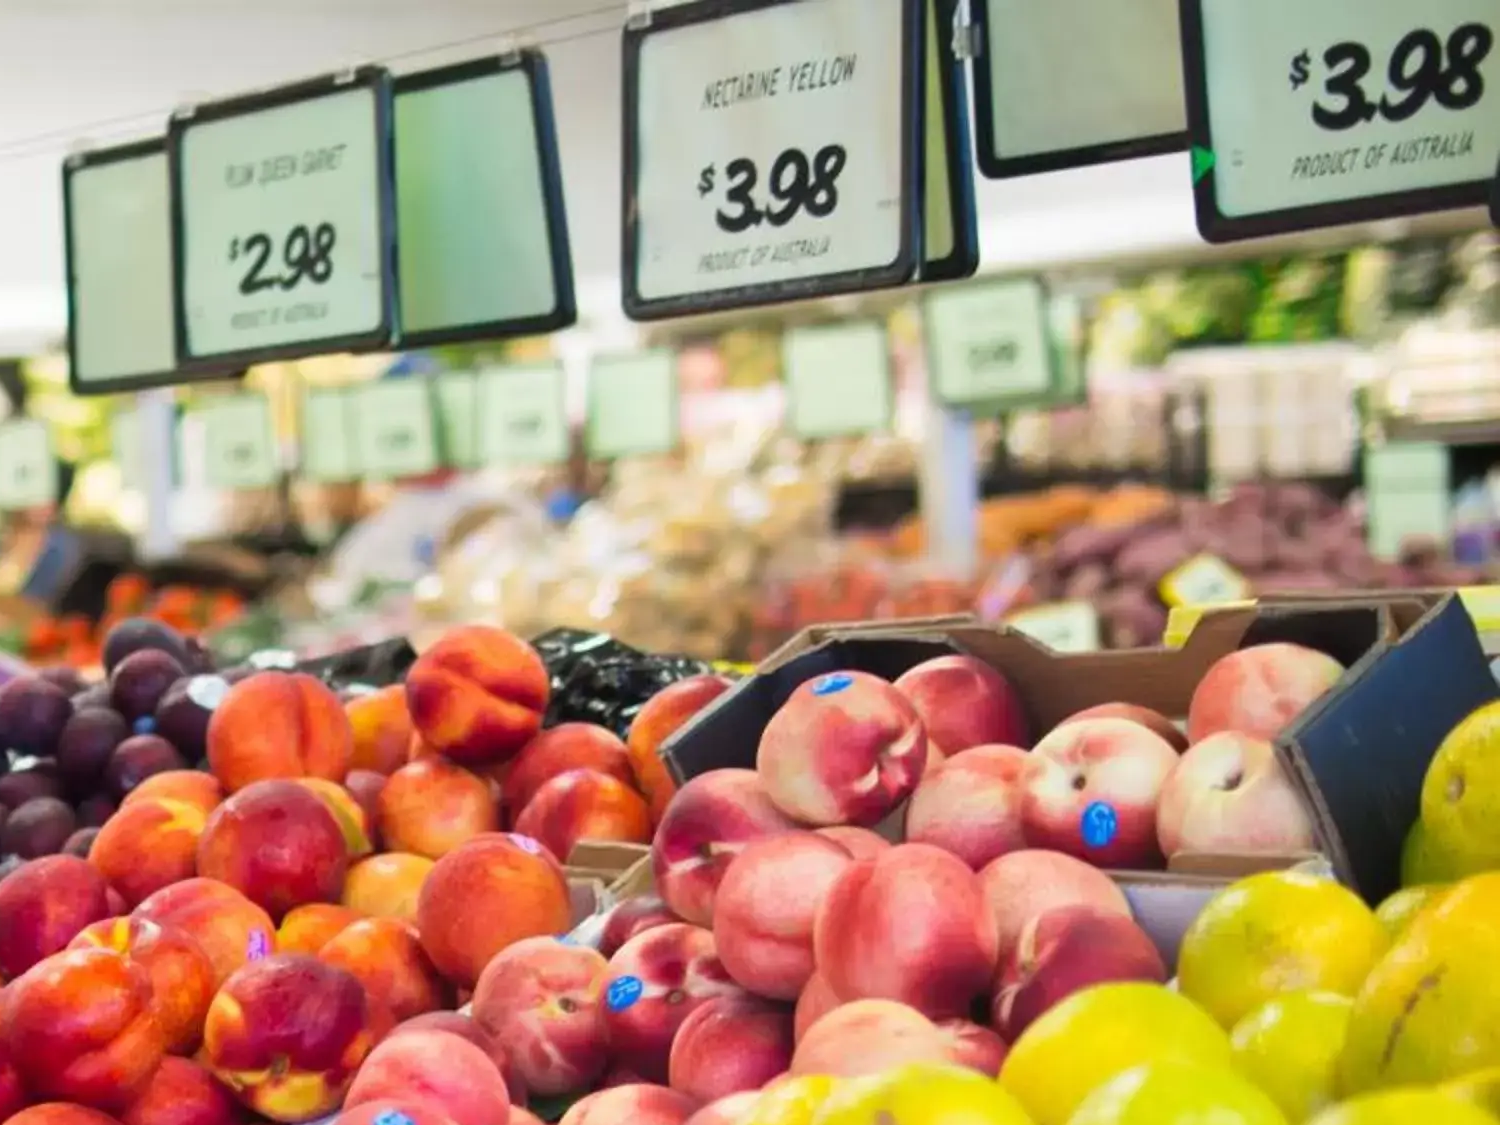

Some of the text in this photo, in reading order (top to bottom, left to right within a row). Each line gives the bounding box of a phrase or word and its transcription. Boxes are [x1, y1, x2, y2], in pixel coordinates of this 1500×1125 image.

[700, 52, 857, 110] NECTARINE YELLOW
[1289, 22, 1494, 131] $3.98
[697, 144, 847, 233] $3.98
[1291, 130, 1474, 180] PRODUCT OF AUSTRALIA
